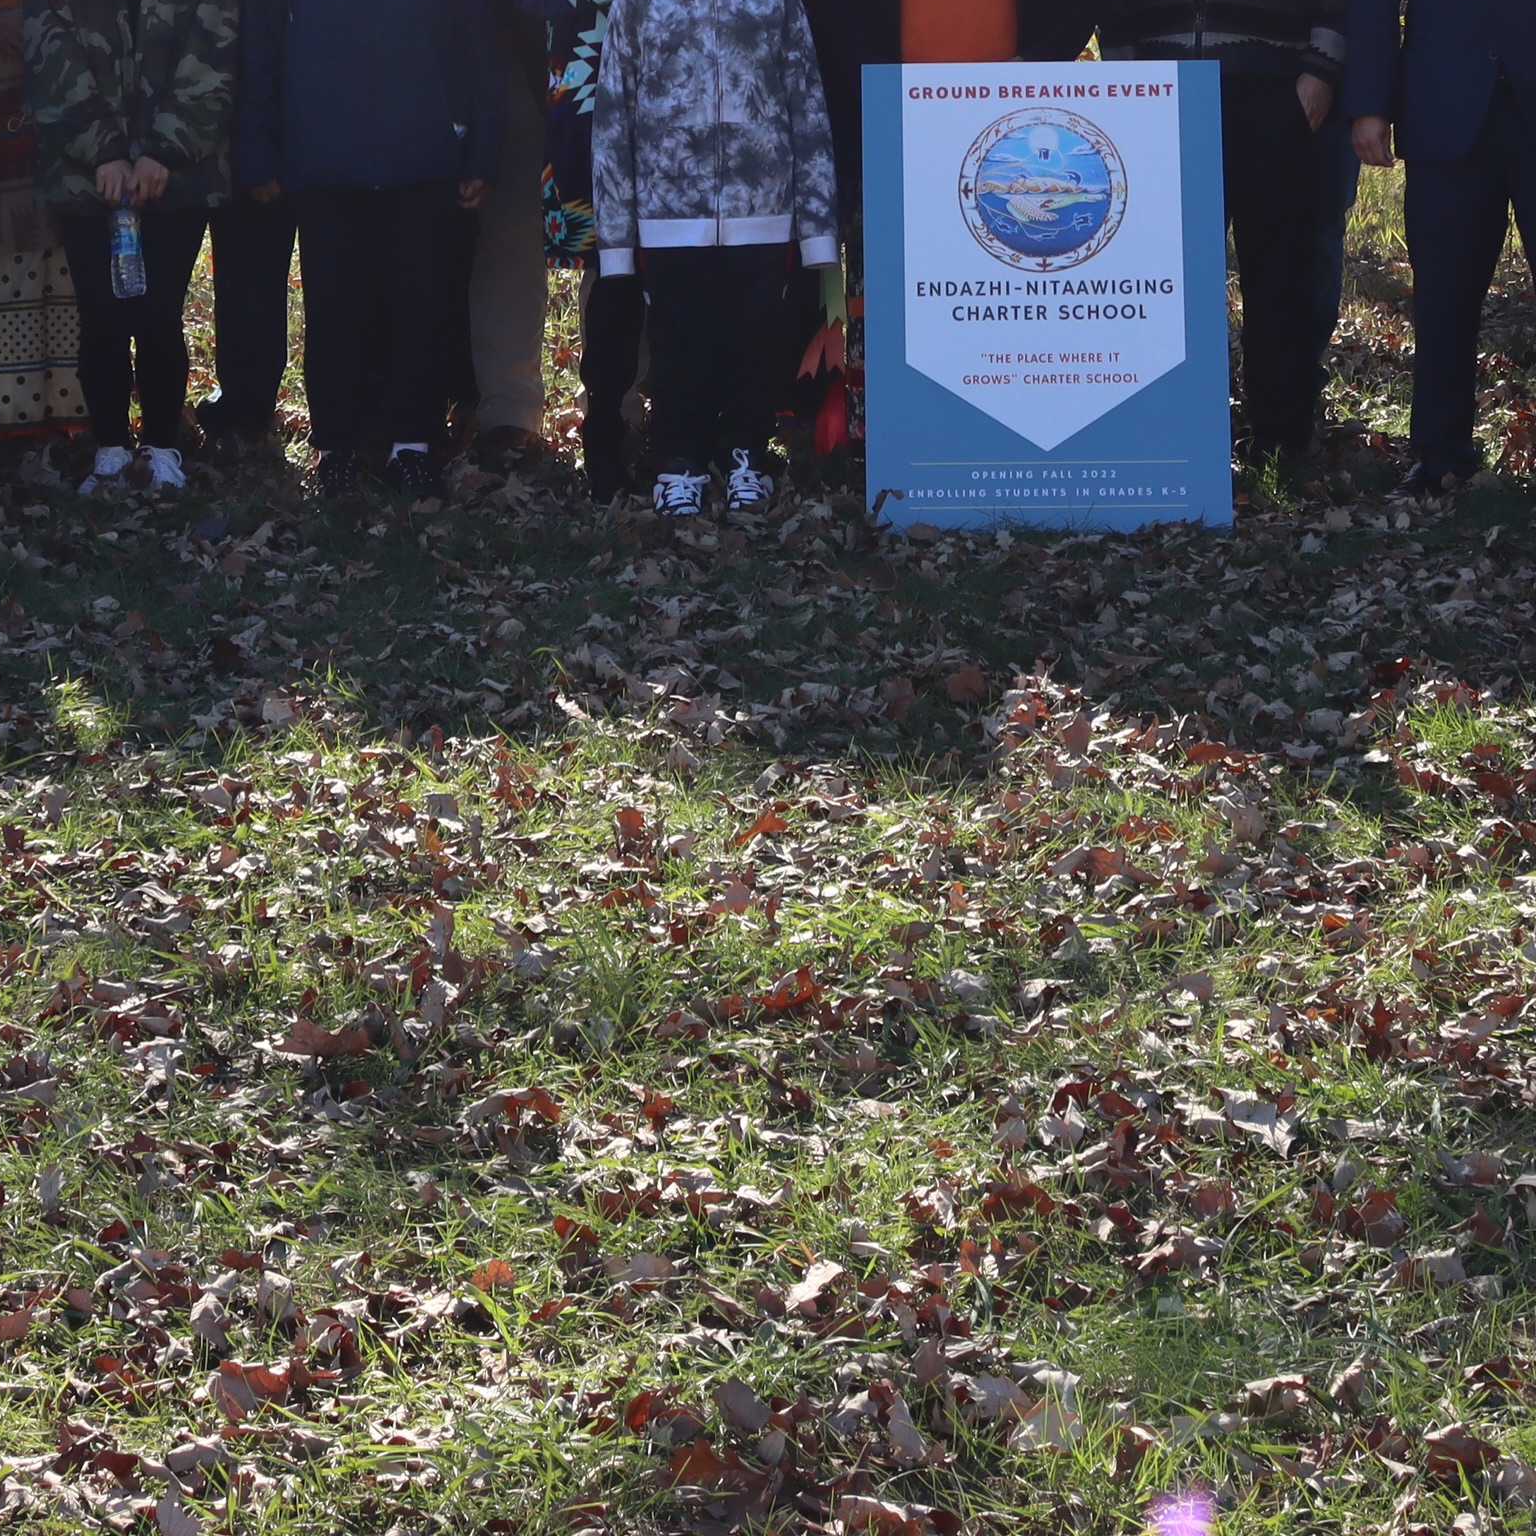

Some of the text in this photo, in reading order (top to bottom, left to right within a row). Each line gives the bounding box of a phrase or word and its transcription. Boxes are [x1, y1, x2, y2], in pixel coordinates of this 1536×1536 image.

[908, 83, 1174, 100] GROUND BREAKING EVENT
[916, 278, 1174, 297] ENDAZHI-NITAAWIGING
[952, 303, 1147, 322] CHARTER SCHOOL
[981, 352, 1120, 364] "THE PLACE WHERE IT
[962, 373, 1139, 385] GROWS" CHARTER SCHOOL
[971, 469, 1116, 480] OPENING FALL 2022
[908, 486, 1187, 498] ENROLLING STUDENTS IN GRADES K-5
